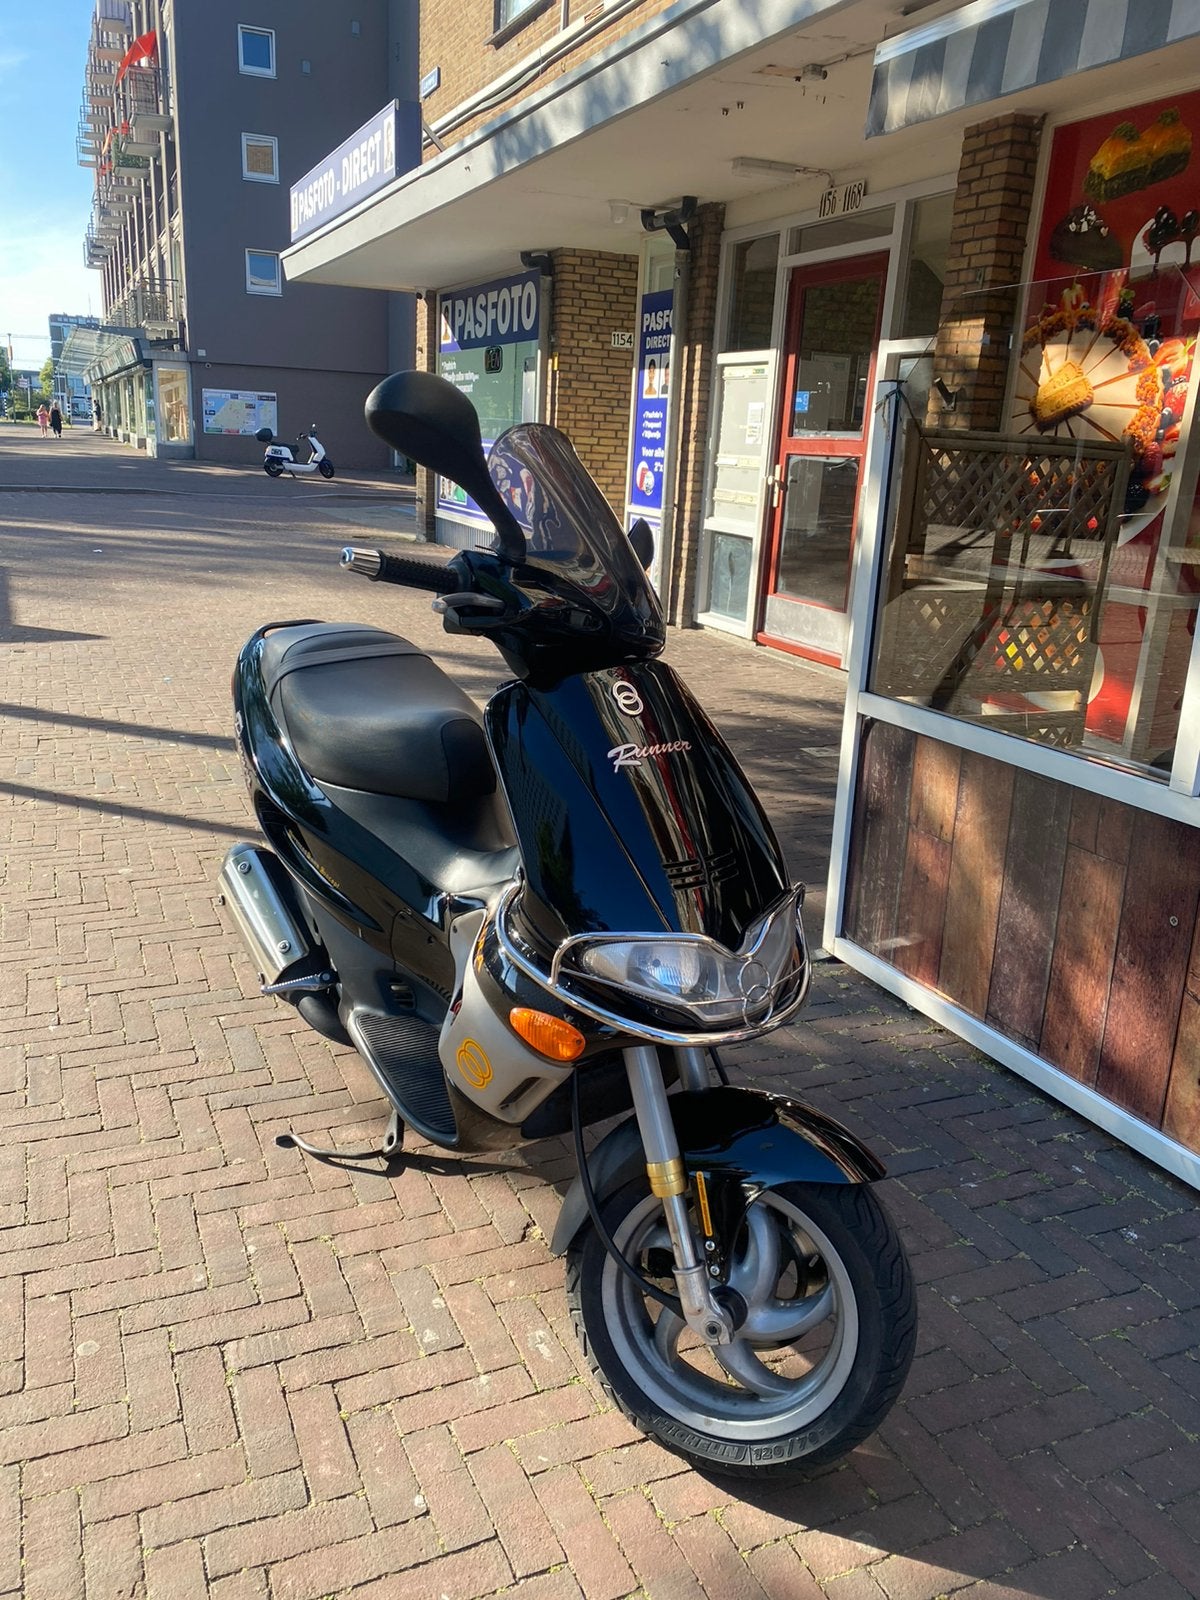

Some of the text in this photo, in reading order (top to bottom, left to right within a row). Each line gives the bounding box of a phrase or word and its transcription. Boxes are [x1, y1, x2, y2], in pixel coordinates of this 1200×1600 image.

[299, 168, 335, 224] PASFOTO
[342, 129, 382, 196] DIRECT
[819, 182, 863, 218] 1156 1168
[454, 281, 537, 341] PASFOTO
[612, 333, 633, 347] 1154
[646, 334, 671, 349] DIRECT
[607, 740, 692, 773] Runner
